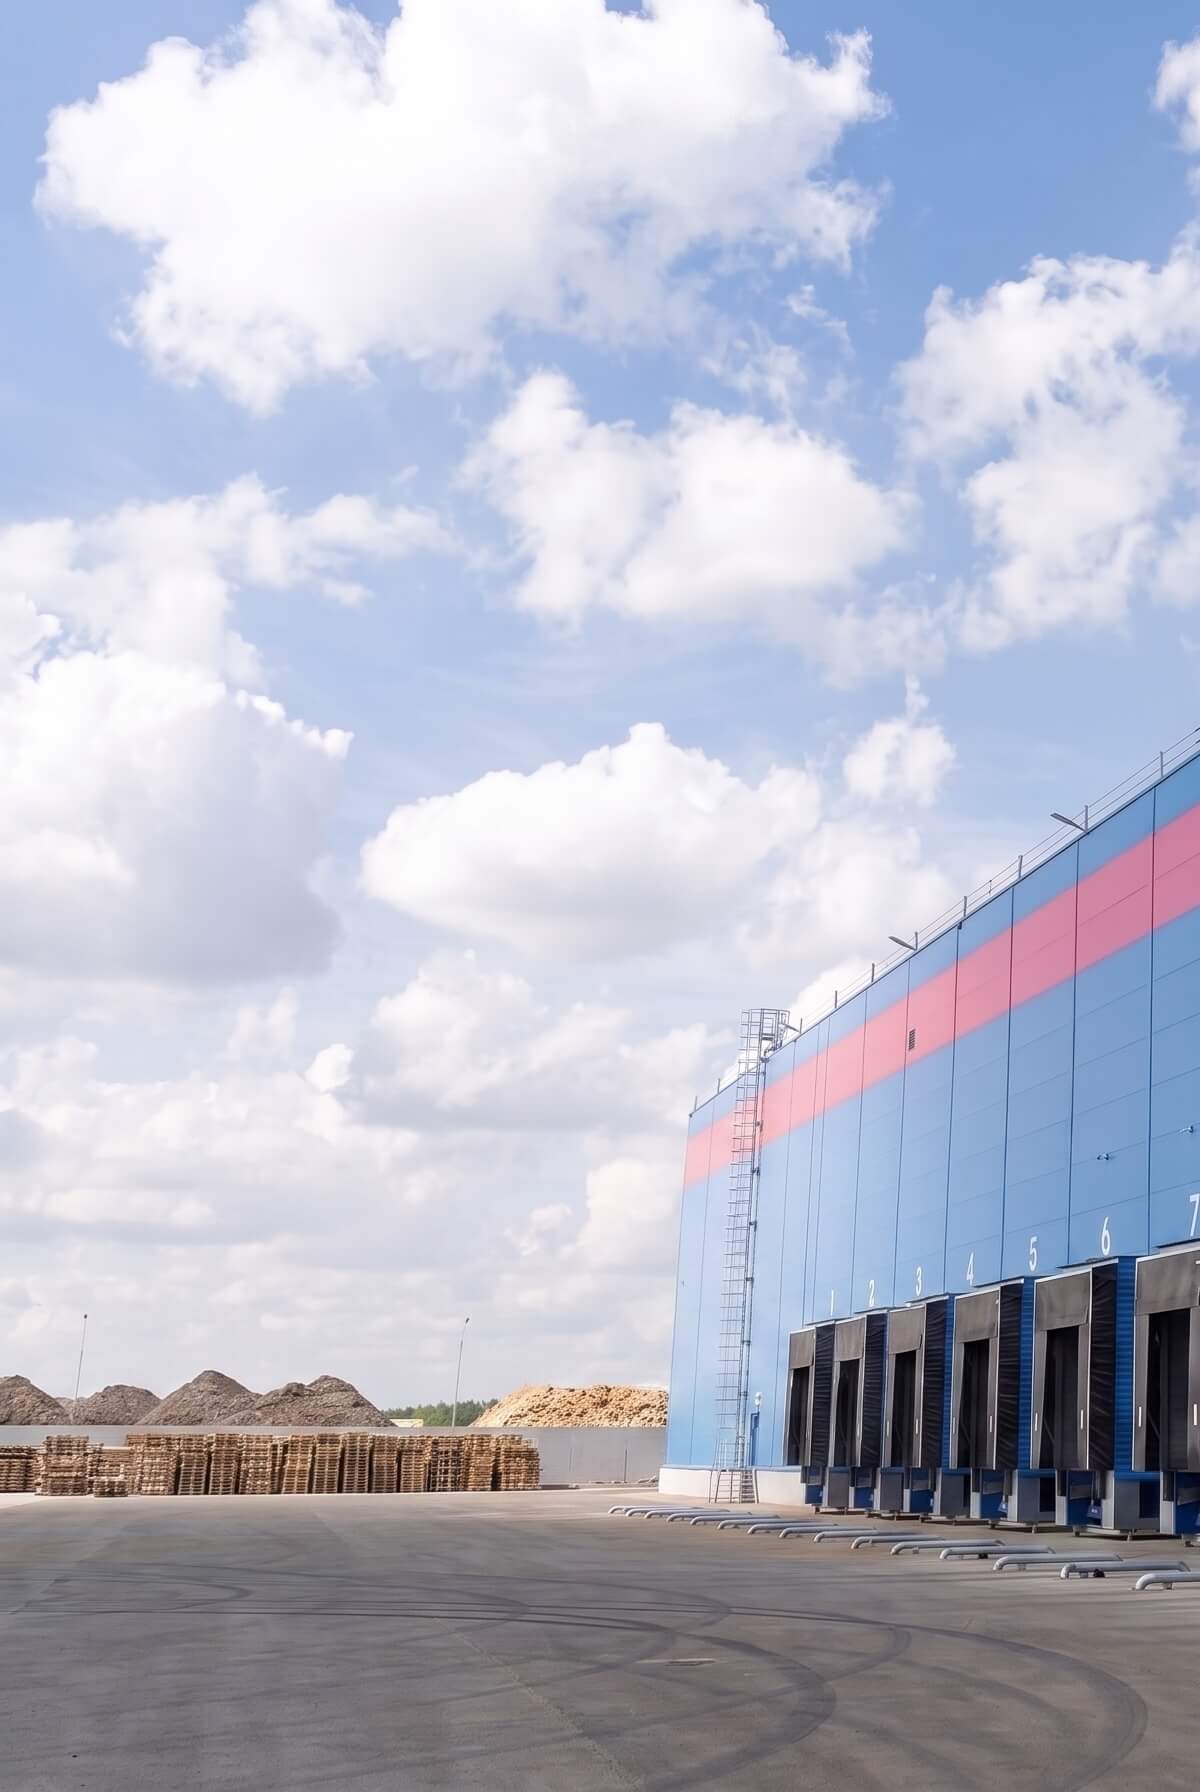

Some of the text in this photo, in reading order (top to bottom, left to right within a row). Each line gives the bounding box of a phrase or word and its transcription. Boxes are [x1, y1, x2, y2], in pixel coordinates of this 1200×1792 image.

[1189, 1194, 1200, 1236] 7
[1101, 1216, 1111, 1256] 6
[966, 1252, 974, 1285] 4
[1029, 1236, 1038, 1271] 5
[868, 1279, 875, 1308] 2
[915, 1266, 922, 1296] 3
